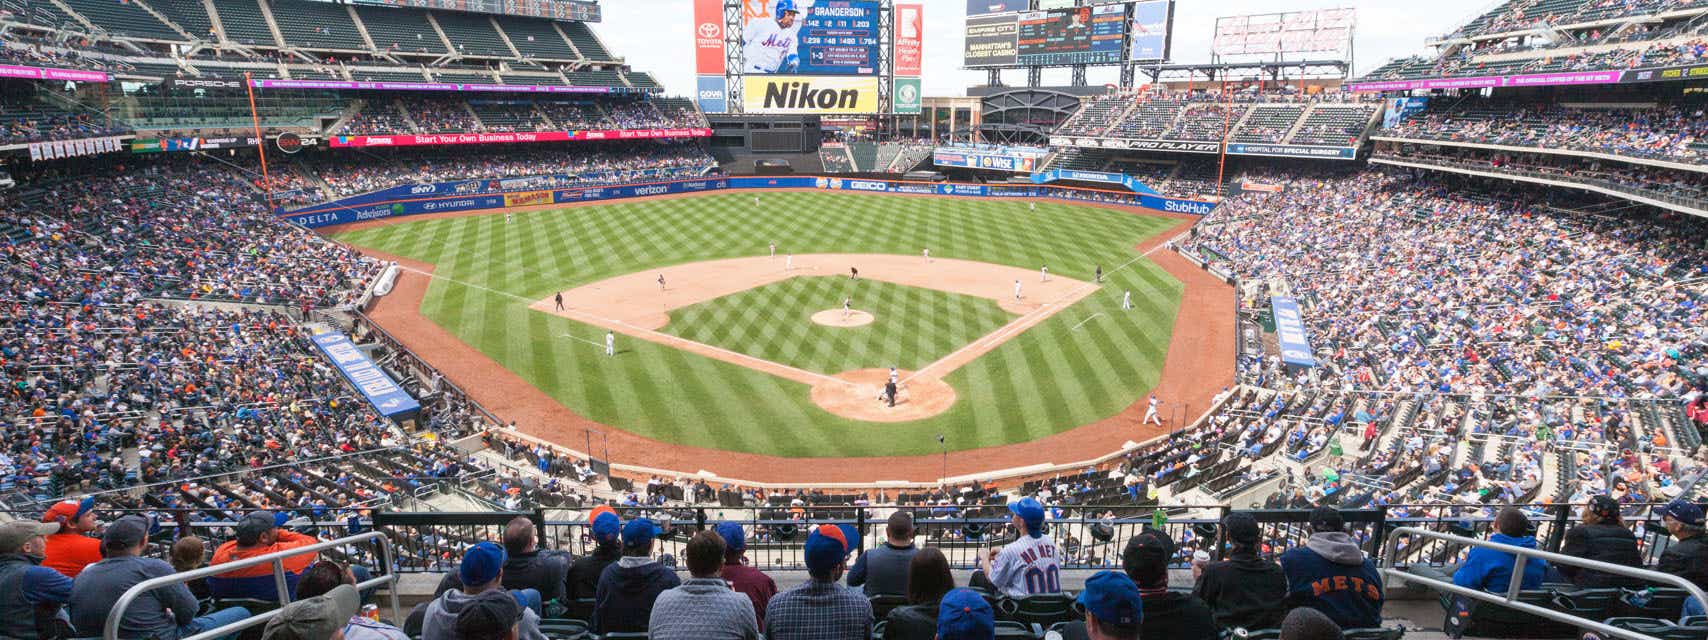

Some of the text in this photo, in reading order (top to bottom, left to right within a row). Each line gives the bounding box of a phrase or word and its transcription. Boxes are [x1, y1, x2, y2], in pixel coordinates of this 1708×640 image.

[814, 7, 864, 17] GRANDERSON
[174, 79, 241, 88] PORSCHE
[763, 81, 859, 109] Nikon
[415, 135, 437, 144] Start
[439, 134, 457, 143] Your
[459, 134, 477, 142] Own
[478, 133, 514, 142] Business
[516, 133, 537, 142] Today
[1129, 140, 1160, 149] PRO
[1161, 141, 1218, 151] PLAYER
[991, 156, 1012, 169] WISE
[411, 184, 433, 194] SNY
[634, 184, 668, 196] verizon
[850, 180, 886, 192] GEICO
[438, 199, 475, 209] HYUNDAI
[1164, 200, 1210, 214] StubHub
[299, 212, 339, 225] DELTA
[1025, 563, 1061, 594] 00
[1311, 575, 1380, 601] METS
